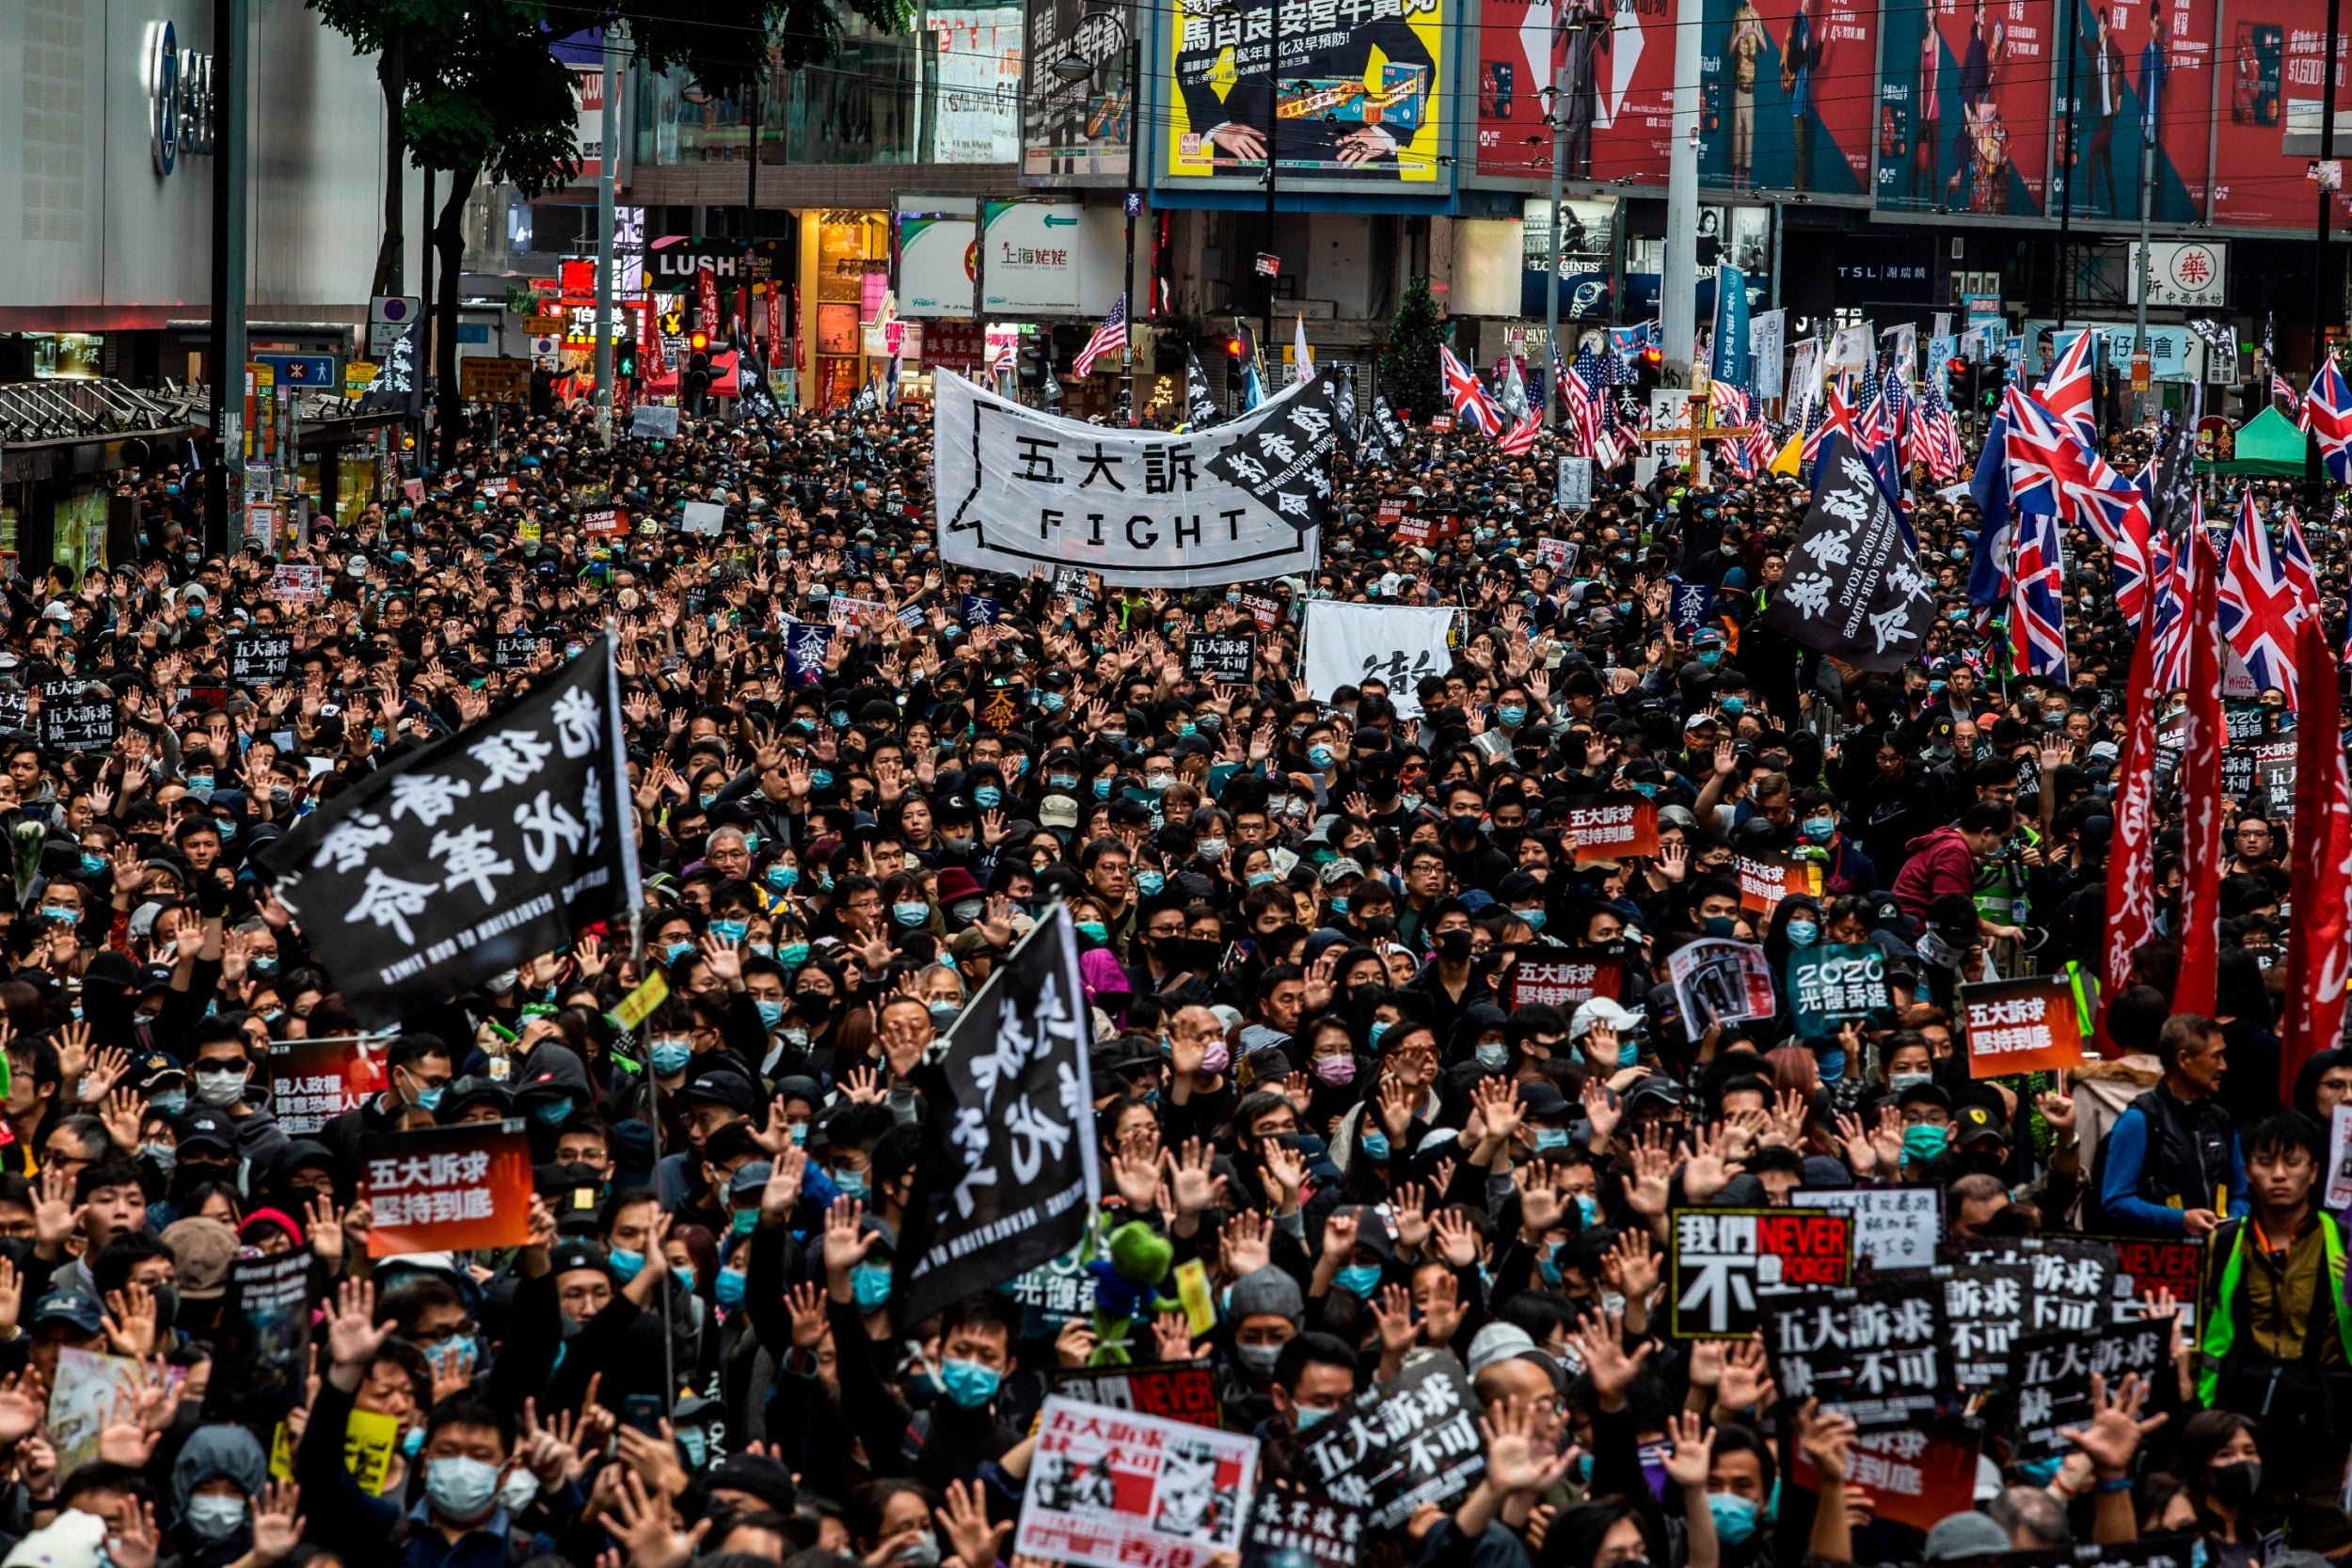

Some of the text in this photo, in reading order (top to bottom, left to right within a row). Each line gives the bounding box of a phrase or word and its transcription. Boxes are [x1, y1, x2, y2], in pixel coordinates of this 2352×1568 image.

[660, 254, 735, 277] LUSH
[739, 257, 771, 266] FESH
[1001, 248, 1068, 265] 上海姥姥
[1534, 261, 1600, 272] LOGINES
[2179, 251, 2210, 284] 藥
[1837, 267, 1877, 277] TSL
[1011, 435, 1242, 494] 五大訴
[1380, 507, 1402, 516] 堅持到
[1041, 509, 1247, 550] FIGHT
[1677, 584, 1705, 628] 天滅中共
[234, 641, 290, 657] 五大訴求
[797, 626, 828, 674] 天滅中共
[1190, 639, 1249, 656] 五大訴求
[233, 657, 289, 674] 缺一不可
[1190, 655, 1248, 672] 缺一不可
[46, 679, 91, 696] 五大訴
[2228, 674, 2252, 690] WHERE
[48, 705, 113, 723] 五大訴求
[48, 721, 113, 741] 缺一不可
[1570, 805, 1634, 827] 五大訴求
[1576, 825, 1634, 846] 堅持到底
[1740, 856, 1786, 883] 五大訴求
[1741, 877, 1788, 900] 堅持到底
[1518, 962, 1597, 985] 五大訴求
[1796, 959, 1884, 988] 2020
[1968, 998, 2046, 1028] 五大訴求
[1972, 1024, 2053, 1055] 堅持到底
[274, 1075, 342, 1096] 殺人政權
[277, 1114, 328, 1133] 卻無法
[368, 1150, 490, 1191] 五大訴求
[370, 1187, 494, 1227] 堅持到底
[1678, 1215, 1847, 1254] 我們 NEVER
[1783, 1258, 1845, 1284] FORGET
[1774, 1298, 1935, 1354] 五大訴求
[2023, 1332, 2160, 1386] 五大訴求
[1779, 1345, 1938, 1398] 缺一不可
[1131, 1371, 1215, 1412] NEVER
[1050, 1409, 1167, 1449] 五大訴求
[1305, 1372, 1460, 1485] 五大訴求
[1327, 1409, 1481, 1507] 缺一不可
